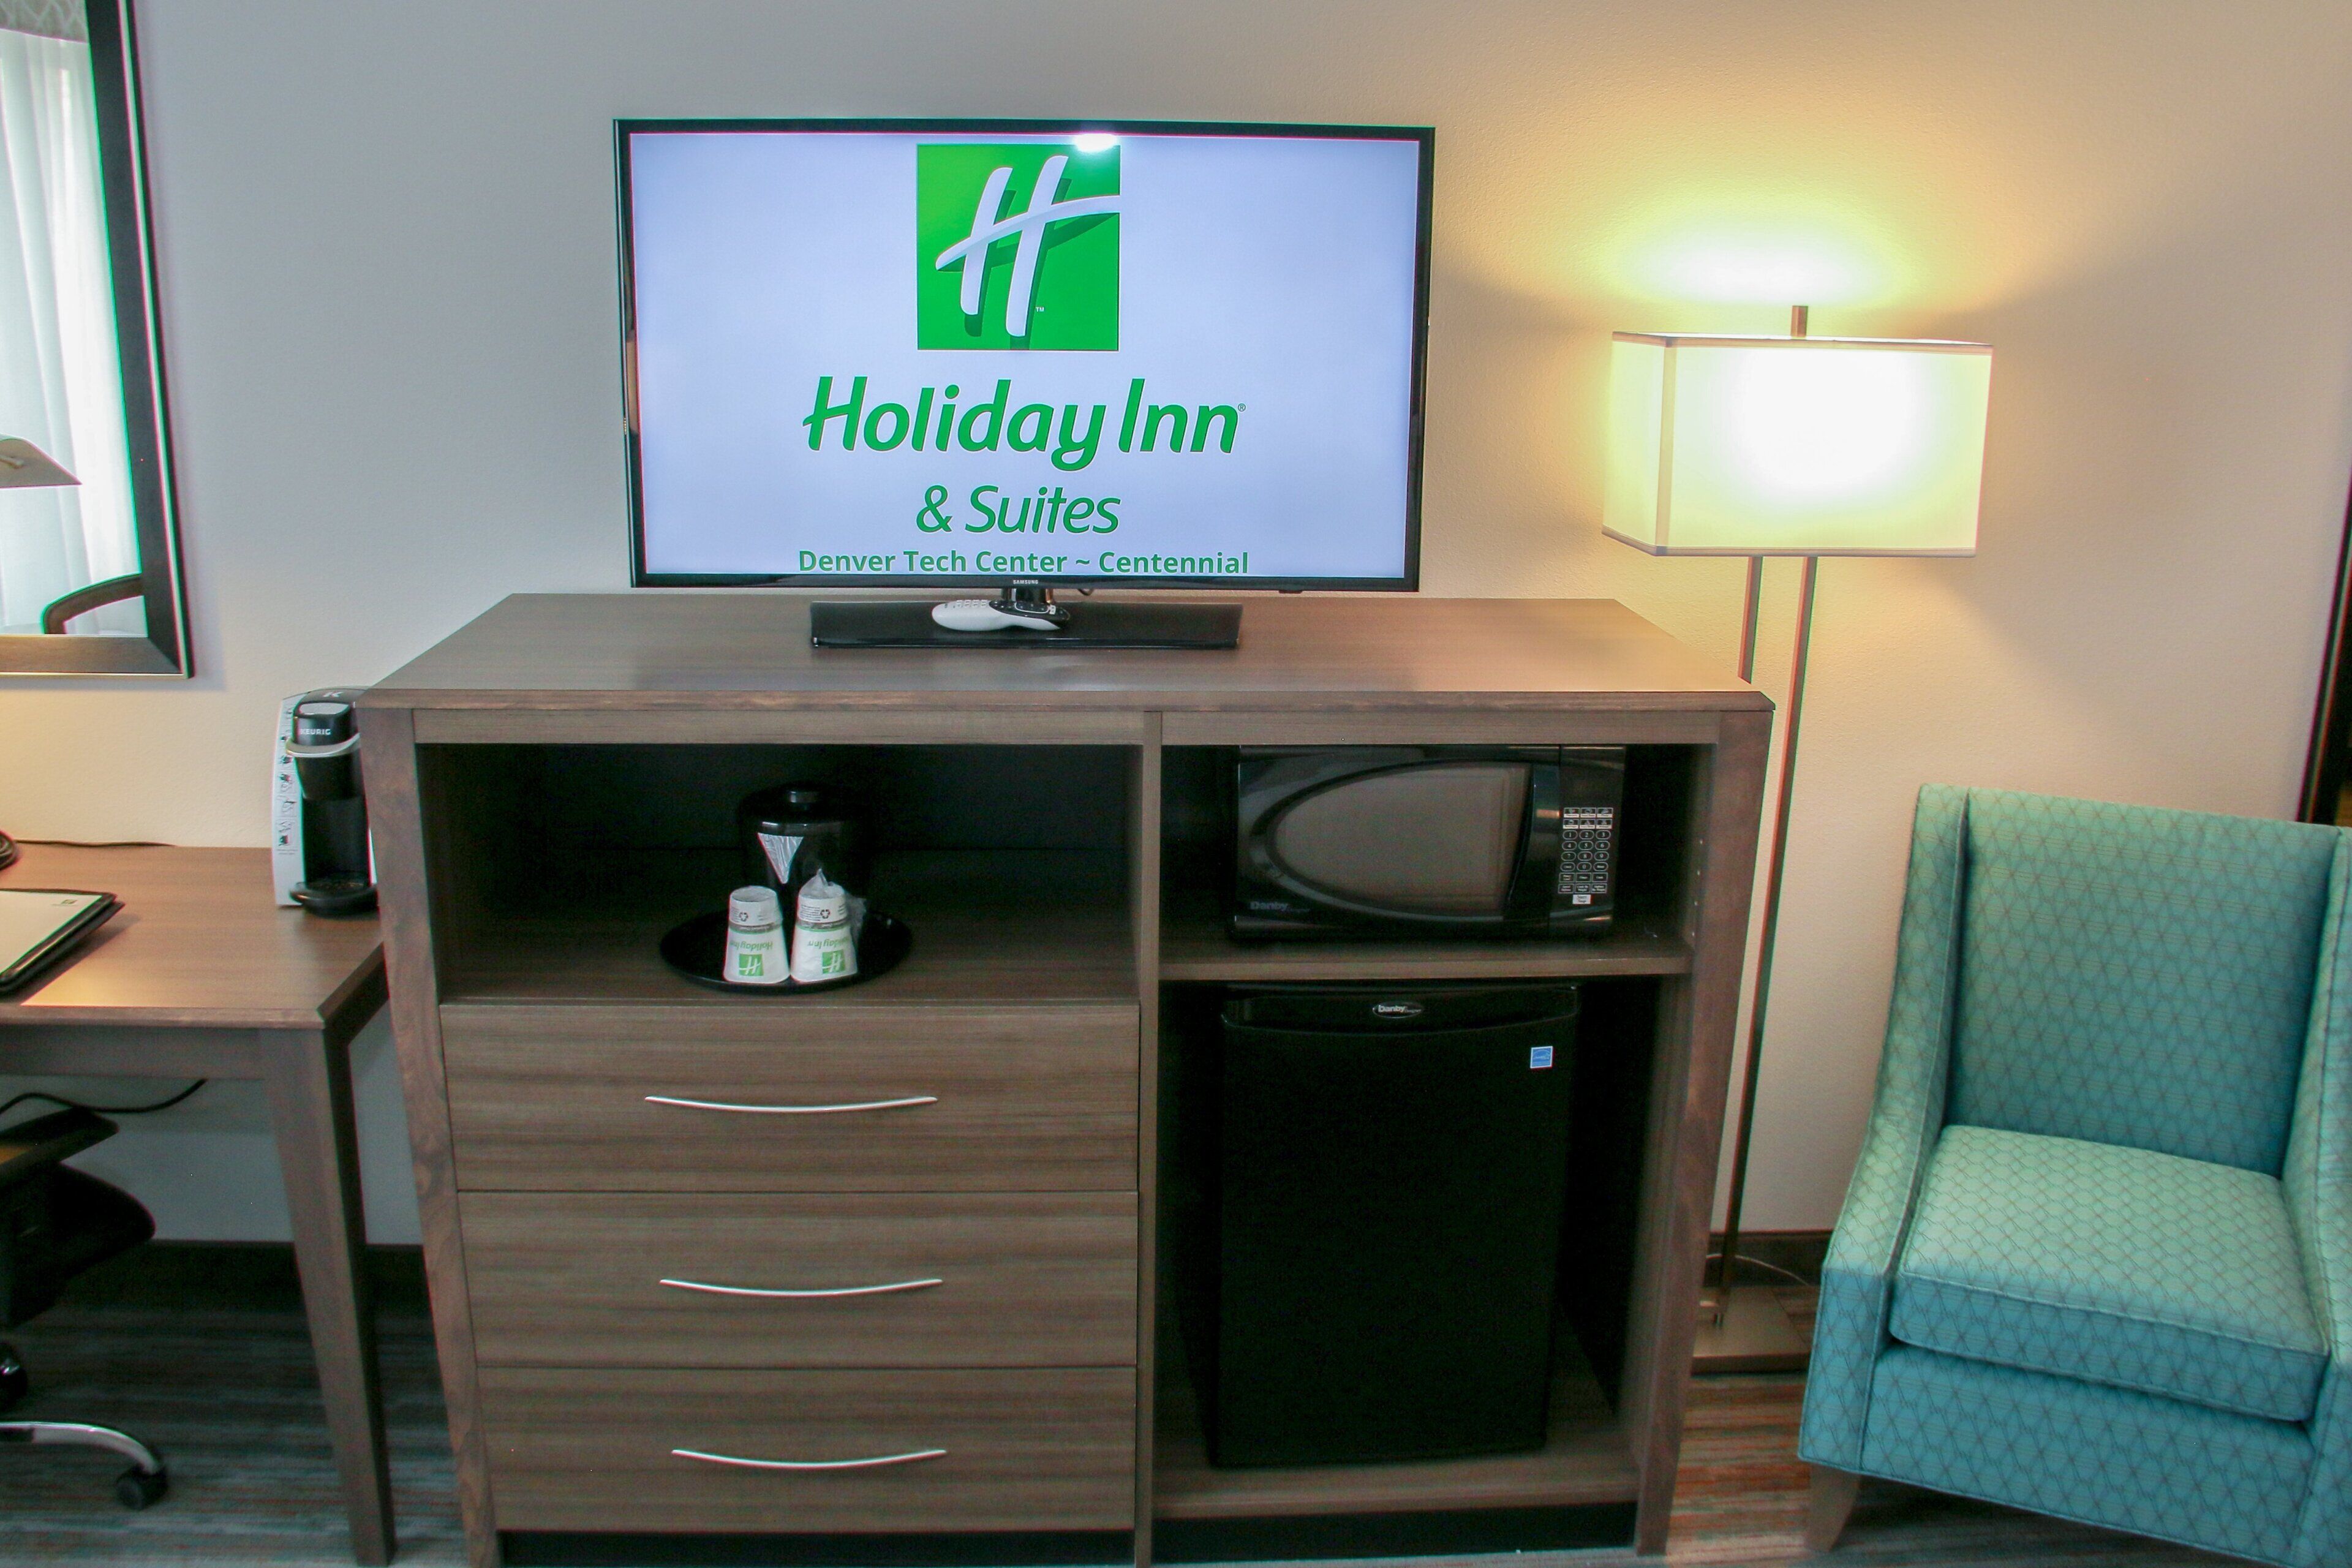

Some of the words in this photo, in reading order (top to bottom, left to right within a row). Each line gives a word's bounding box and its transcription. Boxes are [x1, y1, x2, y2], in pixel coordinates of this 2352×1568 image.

[802, 375, 1105, 472] Holiday
[916, 485, 952, 533] &
[965, 485, 1121, 533] Suites
[798, 550, 896, 572] Denver
[903, 550, 967, 572] Tech
[976, 551, 1068, 573] Center
[1099, 551, 1248, 574] Centennial
